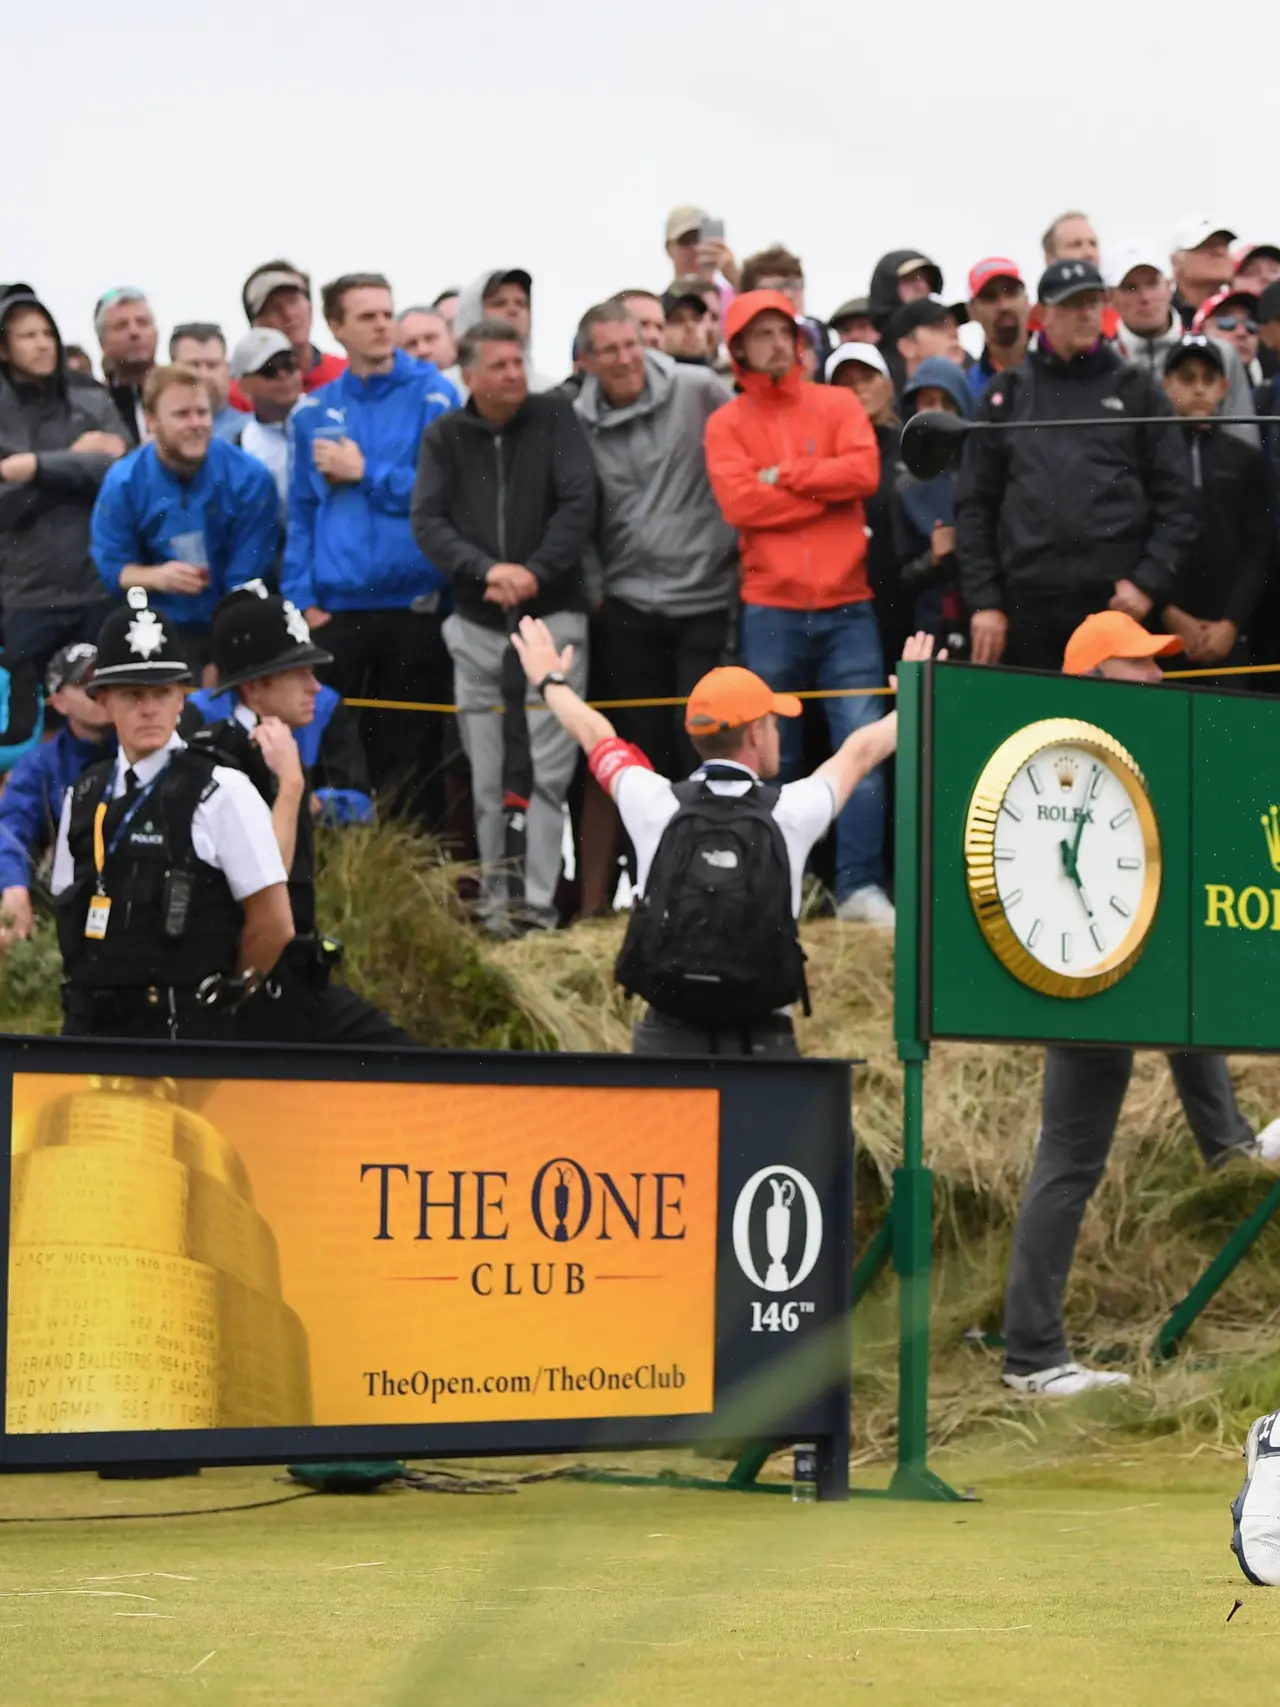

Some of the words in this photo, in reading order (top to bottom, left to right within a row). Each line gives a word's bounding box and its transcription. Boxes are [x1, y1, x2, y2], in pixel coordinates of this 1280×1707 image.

[360, 1164, 509, 1240] THE
[531, 1157, 687, 1242] ONE
[471, 1262, 586, 1296] CLUB
[363, 1364, 687, 1405] TheOpen.com/TheOneClub
